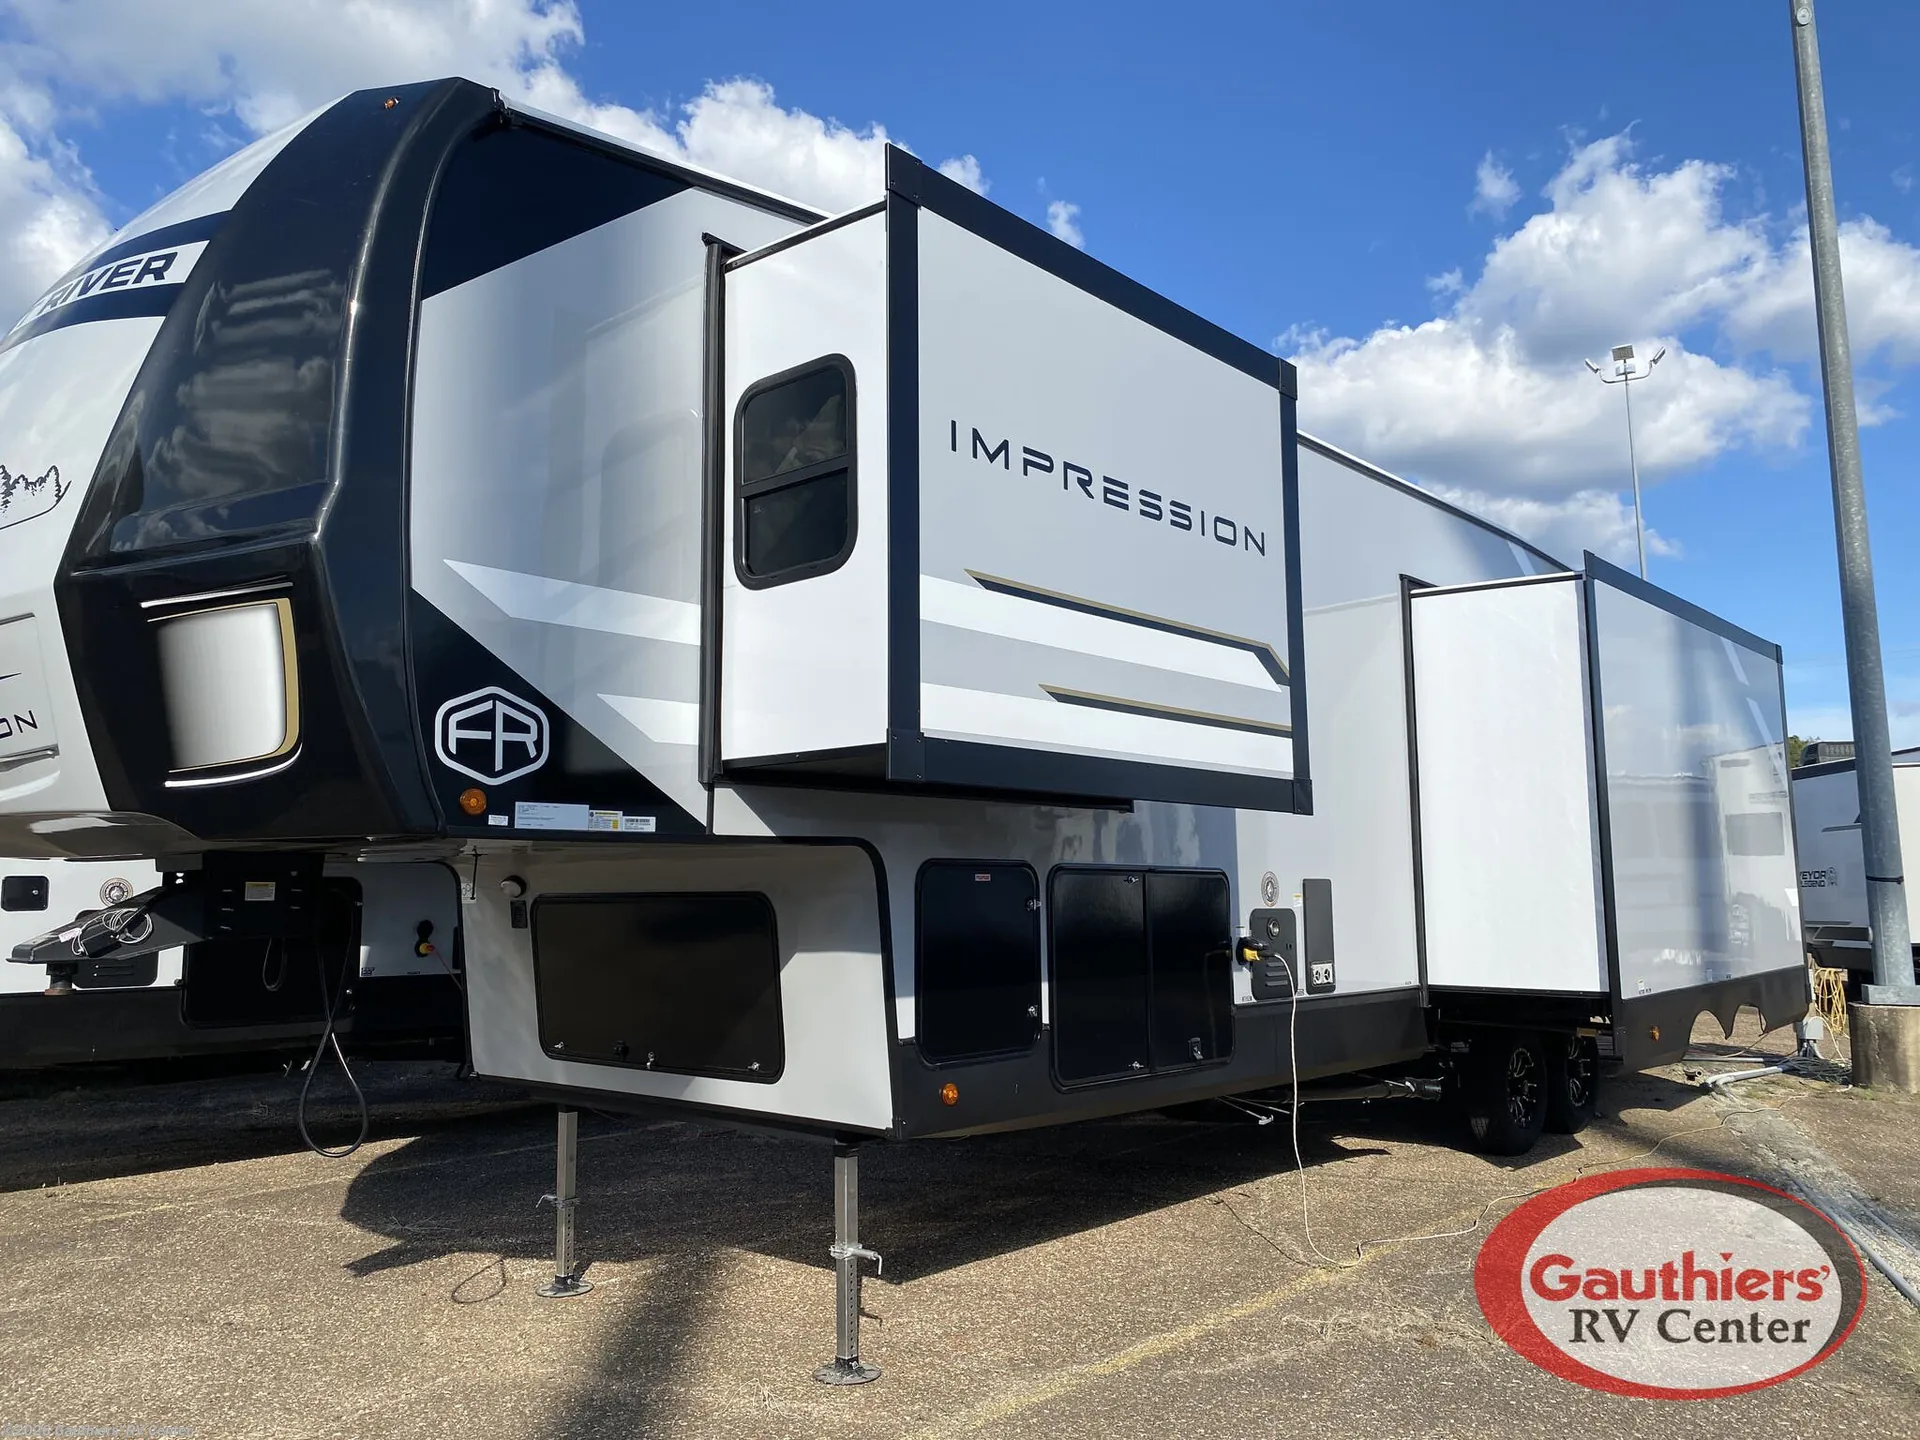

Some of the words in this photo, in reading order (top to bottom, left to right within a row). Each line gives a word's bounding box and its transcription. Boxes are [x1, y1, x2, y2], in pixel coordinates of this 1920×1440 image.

[37, 251, 178, 315] RIVER
[951, 420, 1265, 557] IMPRESSION
[1800, 870, 1826, 880] EYOR
